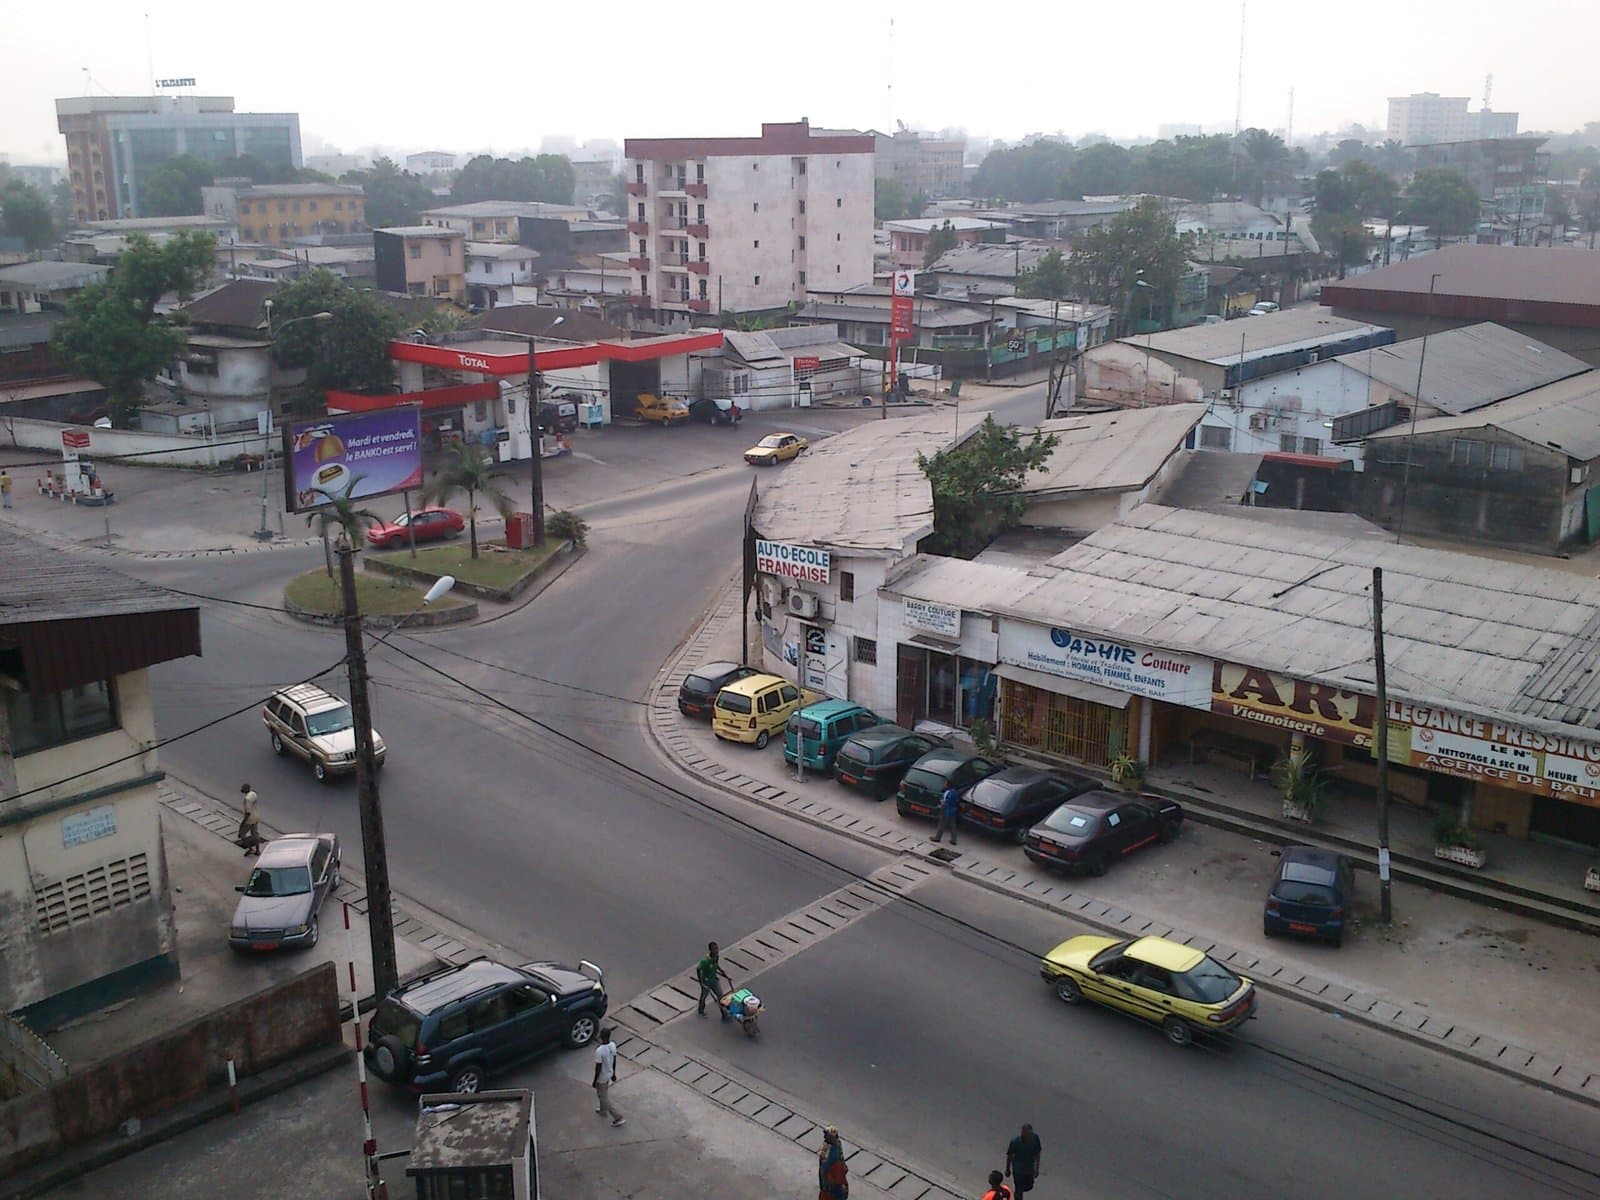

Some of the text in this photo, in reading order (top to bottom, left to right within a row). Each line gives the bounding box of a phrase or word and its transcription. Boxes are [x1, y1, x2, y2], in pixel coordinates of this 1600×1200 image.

[458, 354, 490, 369] TOTAL
[345, 453, 353, 462] le
[354, 448, 382, 461] BANKO
[383, 446, 394, 455] est
[395, 443, 412, 454] servi
[347, 429, 415, 449] Mardi et vendredi,
[1050, 627, 1136, 665] SAPHIR
[1141, 652, 1191, 675] Couture
[1071, 661, 1102, 677] HOMMES,
[1103, 668, 1132, 682] FEMMES,
[1134, 674, 1166, 688] ENFANTS
[1232, 704, 1325, 736] Viennoiserie
[1490, 744, 1508, 754] LE
[1426, 755, 1510, 780] AGENCE
[1516, 774, 1544, 787] DE
[1551, 781, 1596, 798] BALI
[1438, 746, 1488, 764] NETTOYAGE
[1490, 758, 1497, 766] A
[1499, 760, 1514, 769] SEC
[1517, 763, 1530, 773] EN
[1547, 770, 1578, 783] HEURE
